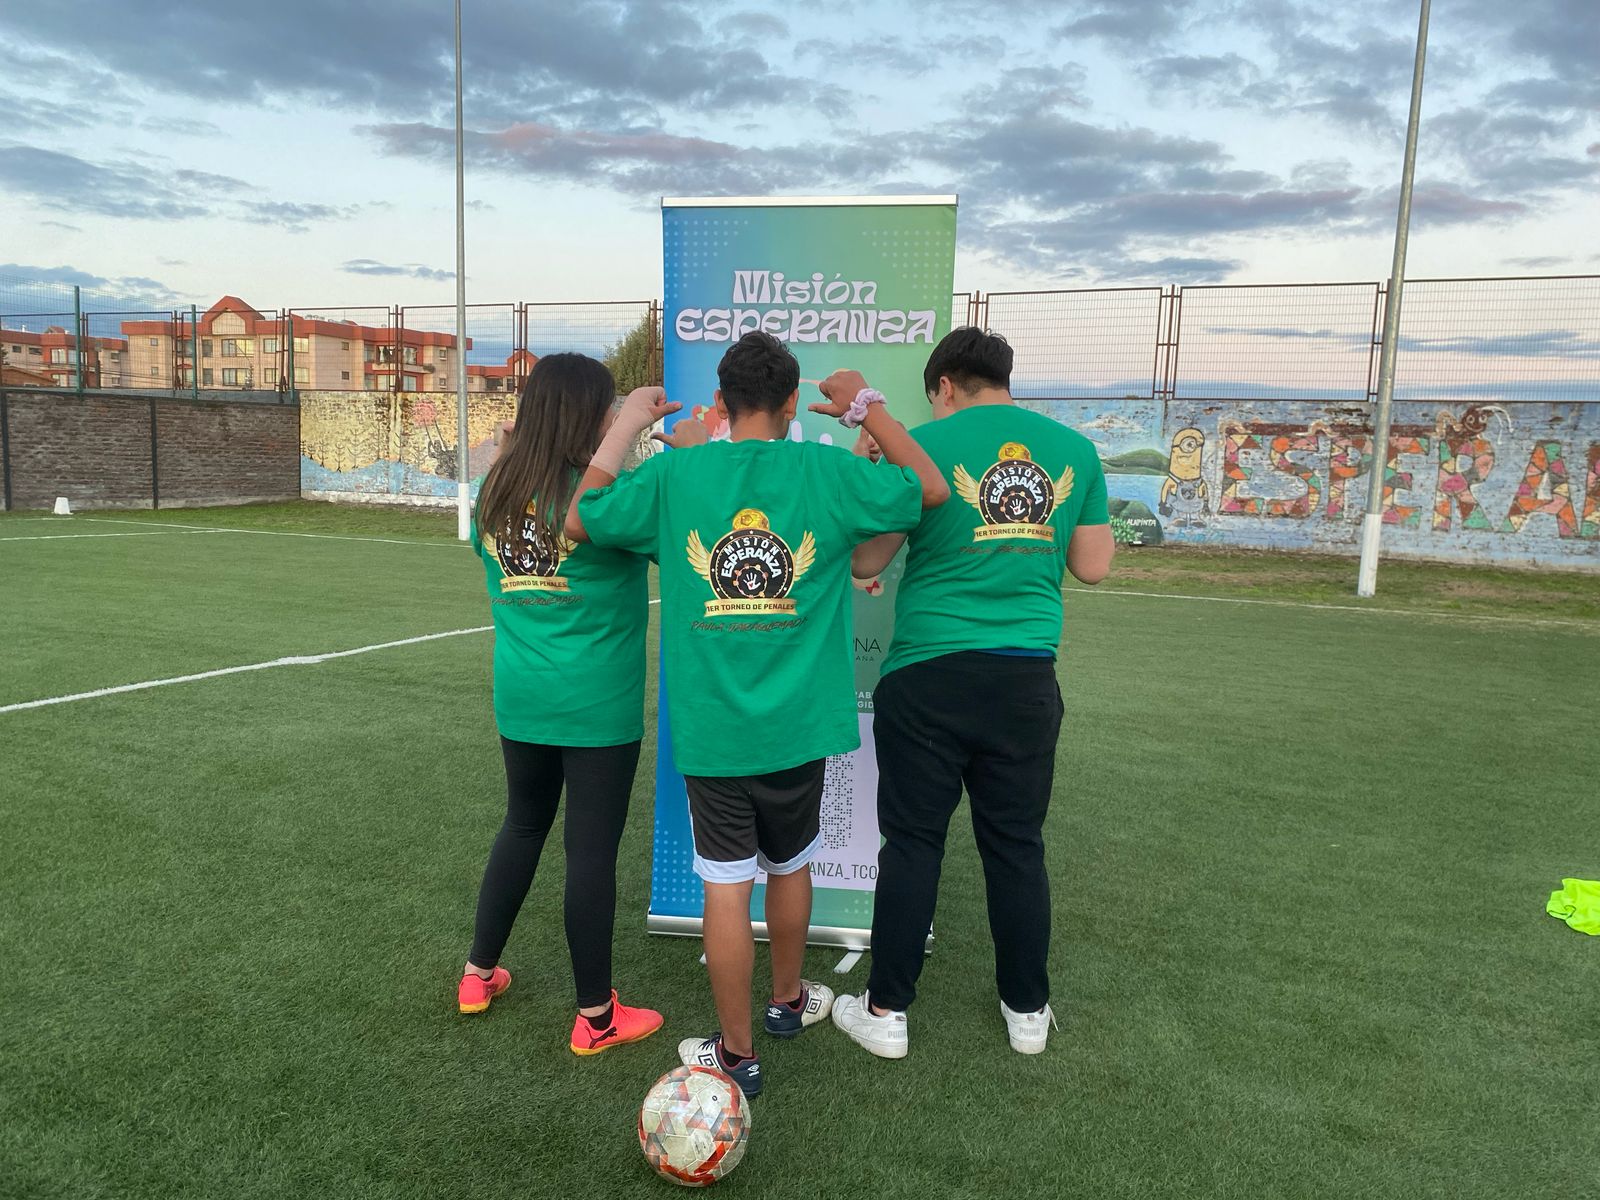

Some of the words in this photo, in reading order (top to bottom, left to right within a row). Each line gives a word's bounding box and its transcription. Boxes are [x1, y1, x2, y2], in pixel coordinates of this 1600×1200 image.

[732, 270, 877, 304] Misión
[675, 308, 936, 344] ESPERANZA
[990, 475, 1043, 505] ESPERANZA
[989, 528, 1016, 536] TORNEO
[721, 547, 782, 578] ESPERANZA
[721, 603, 751, 611] TORNEO
[763, 603, 794, 611] PENALES
[854, 637, 882, 653] NA
[855, 691, 873, 699] AB
